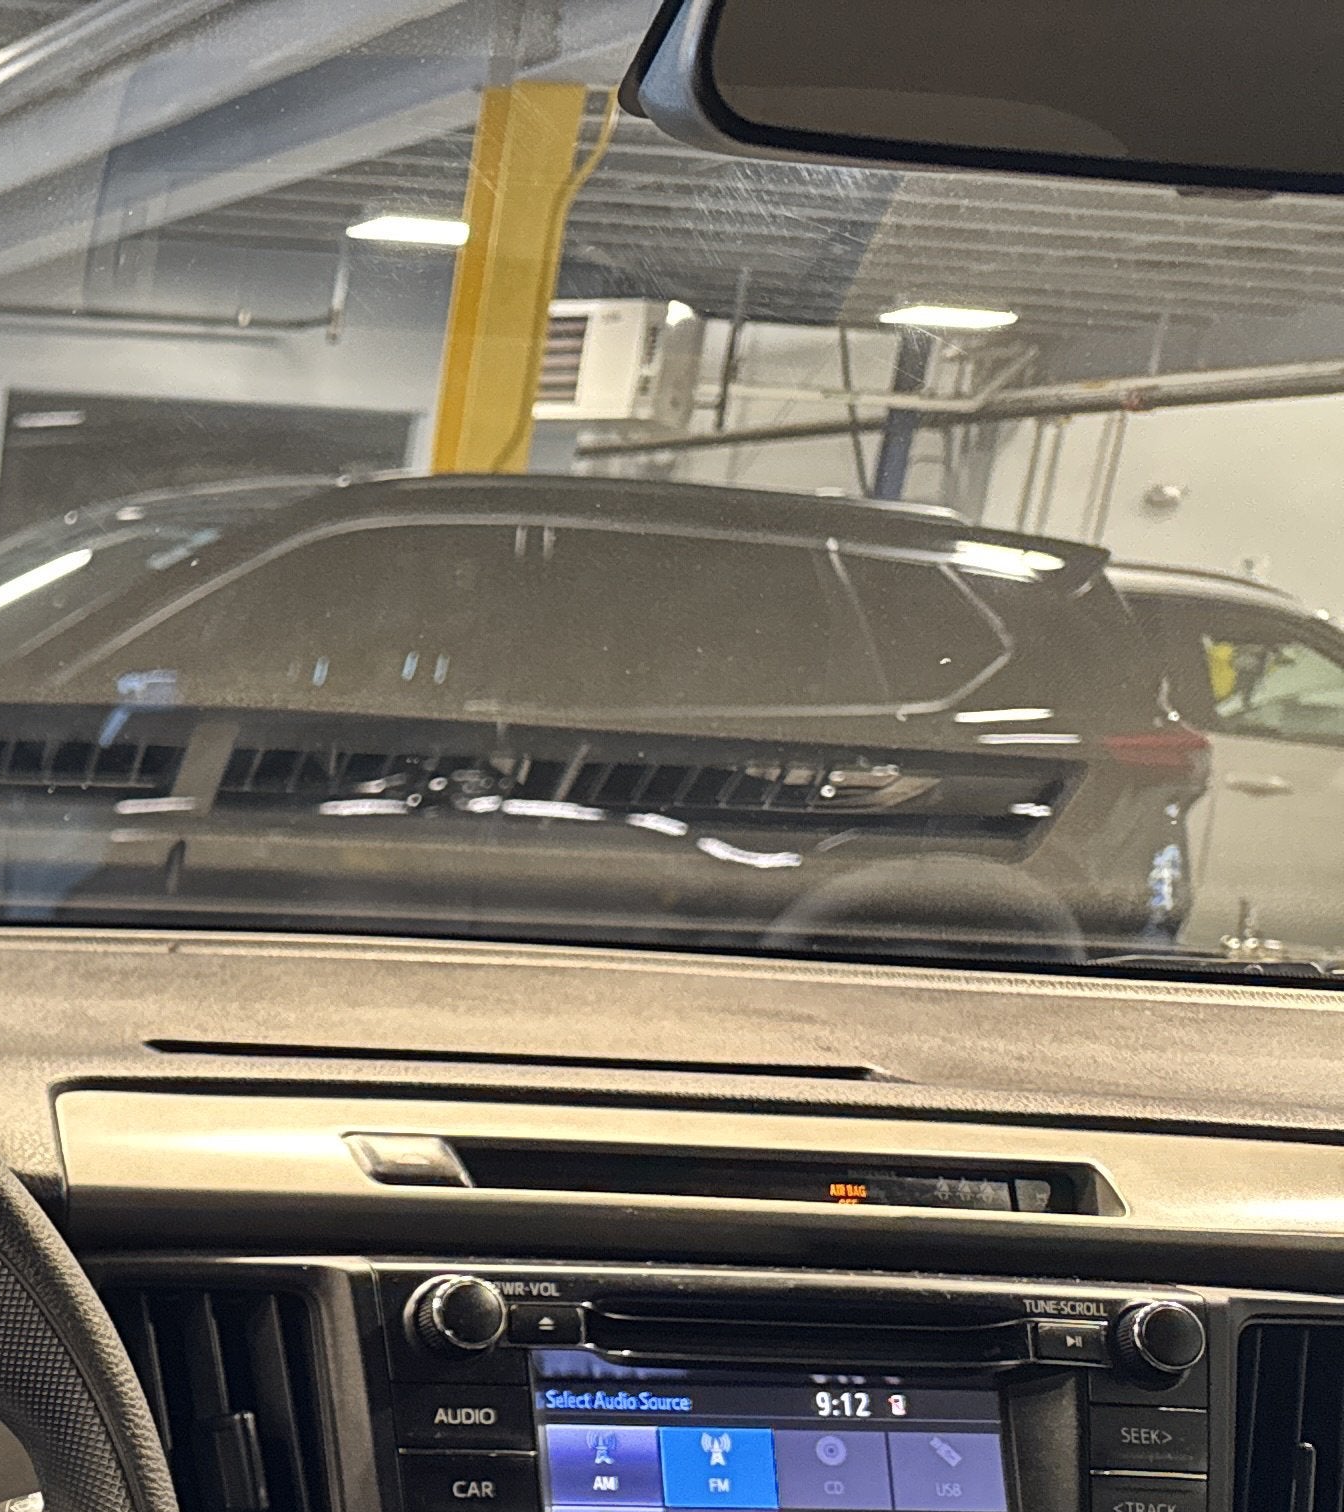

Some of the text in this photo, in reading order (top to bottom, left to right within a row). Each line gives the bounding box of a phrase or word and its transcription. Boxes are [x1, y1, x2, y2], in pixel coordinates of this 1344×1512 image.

[546, 1389, 692, 1412] Select Audio Source
[815, 1391, 872, 1417] 9:12
[434, 1408, 496, 1425] AUDIO
[452, 1481, 495, 1498] CAR
[593, 1477, 618, 1491] AM
[709, 1479, 729, 1493] FM
[824, 1482, 845, 1495] CD
